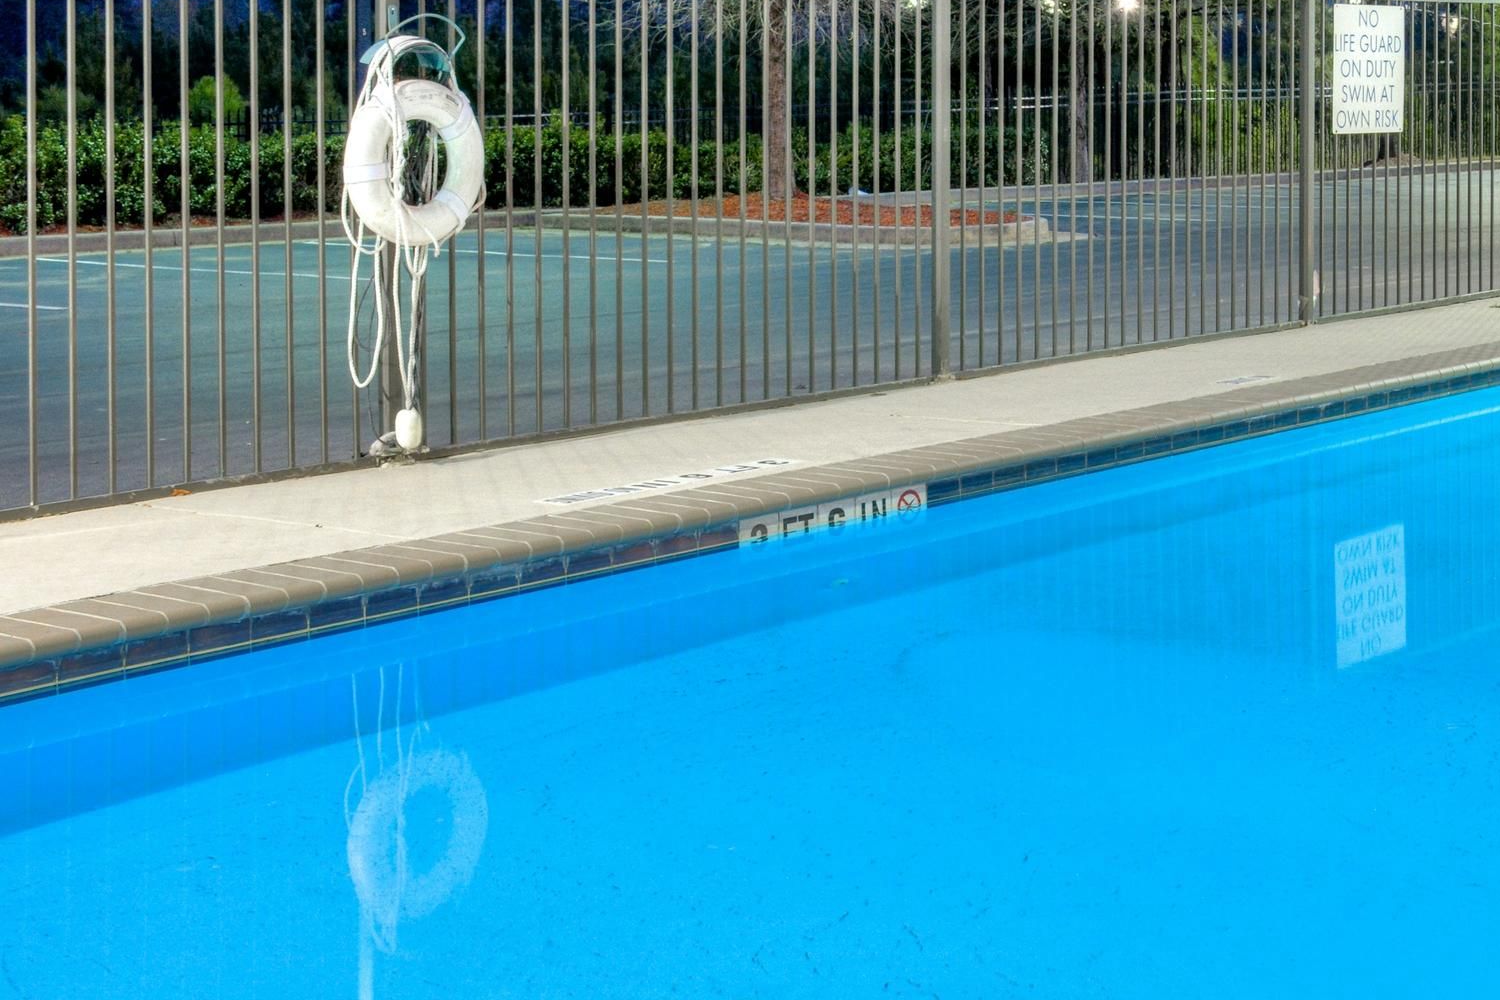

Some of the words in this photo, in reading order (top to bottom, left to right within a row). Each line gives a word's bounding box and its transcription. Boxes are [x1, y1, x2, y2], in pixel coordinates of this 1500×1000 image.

[1358, 9, 1379, 28] NO
[1334, 34, 1355, 53] LIFE
[1360, 34, 1401, 54] GUARD
[1340, 59, 1361, 78] ON
[1366, 59, 1396, 78] DUTY
[1341, 84, 1376, 103] SWIM
[1380, 84, 1395, 103] AT
[1336, 109, 1370, 129] OWN
[1375, 109, 1399, 128] RISK
[861, 497, 887, 522] IN
